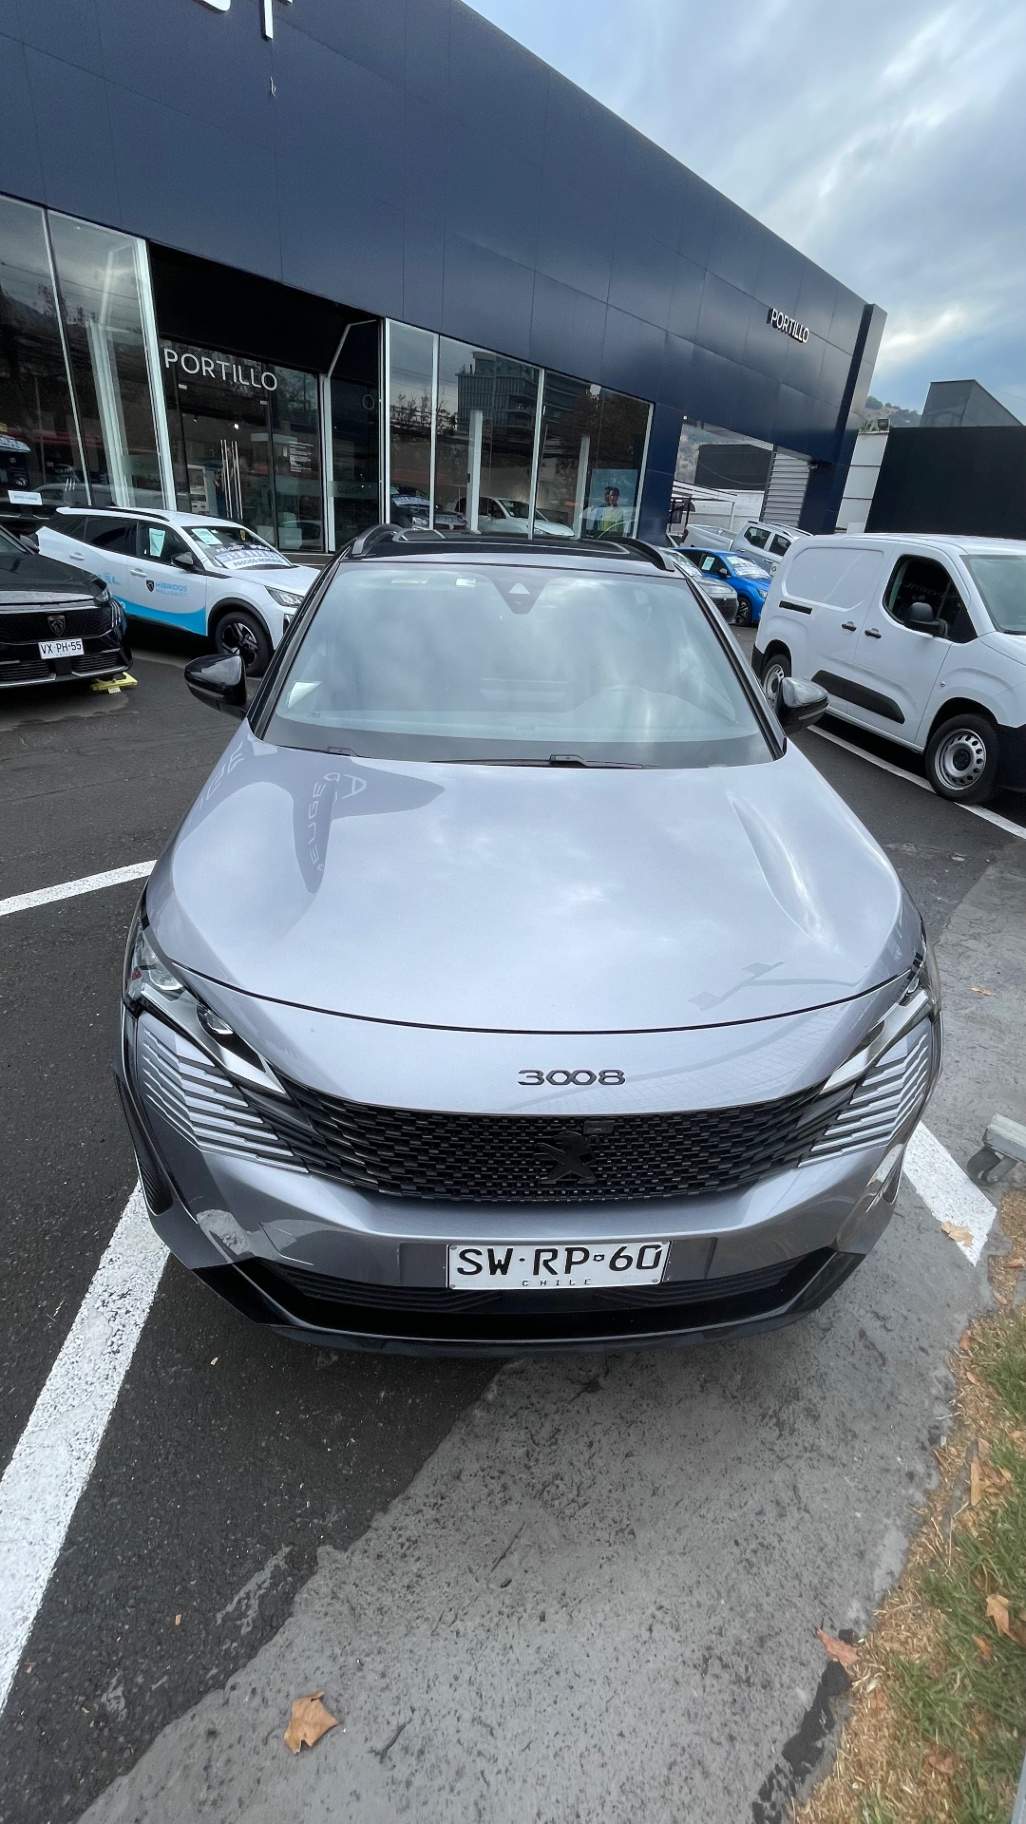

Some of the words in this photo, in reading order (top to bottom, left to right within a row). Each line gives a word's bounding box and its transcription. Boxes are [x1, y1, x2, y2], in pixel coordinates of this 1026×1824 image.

[771, 308, 810, 343] PORTILLO
[164, 348, 278, 391] PORTILLO
[517, 1069, 626, 1086] 3008
[521, 1278, 592, 1287] CHILE
